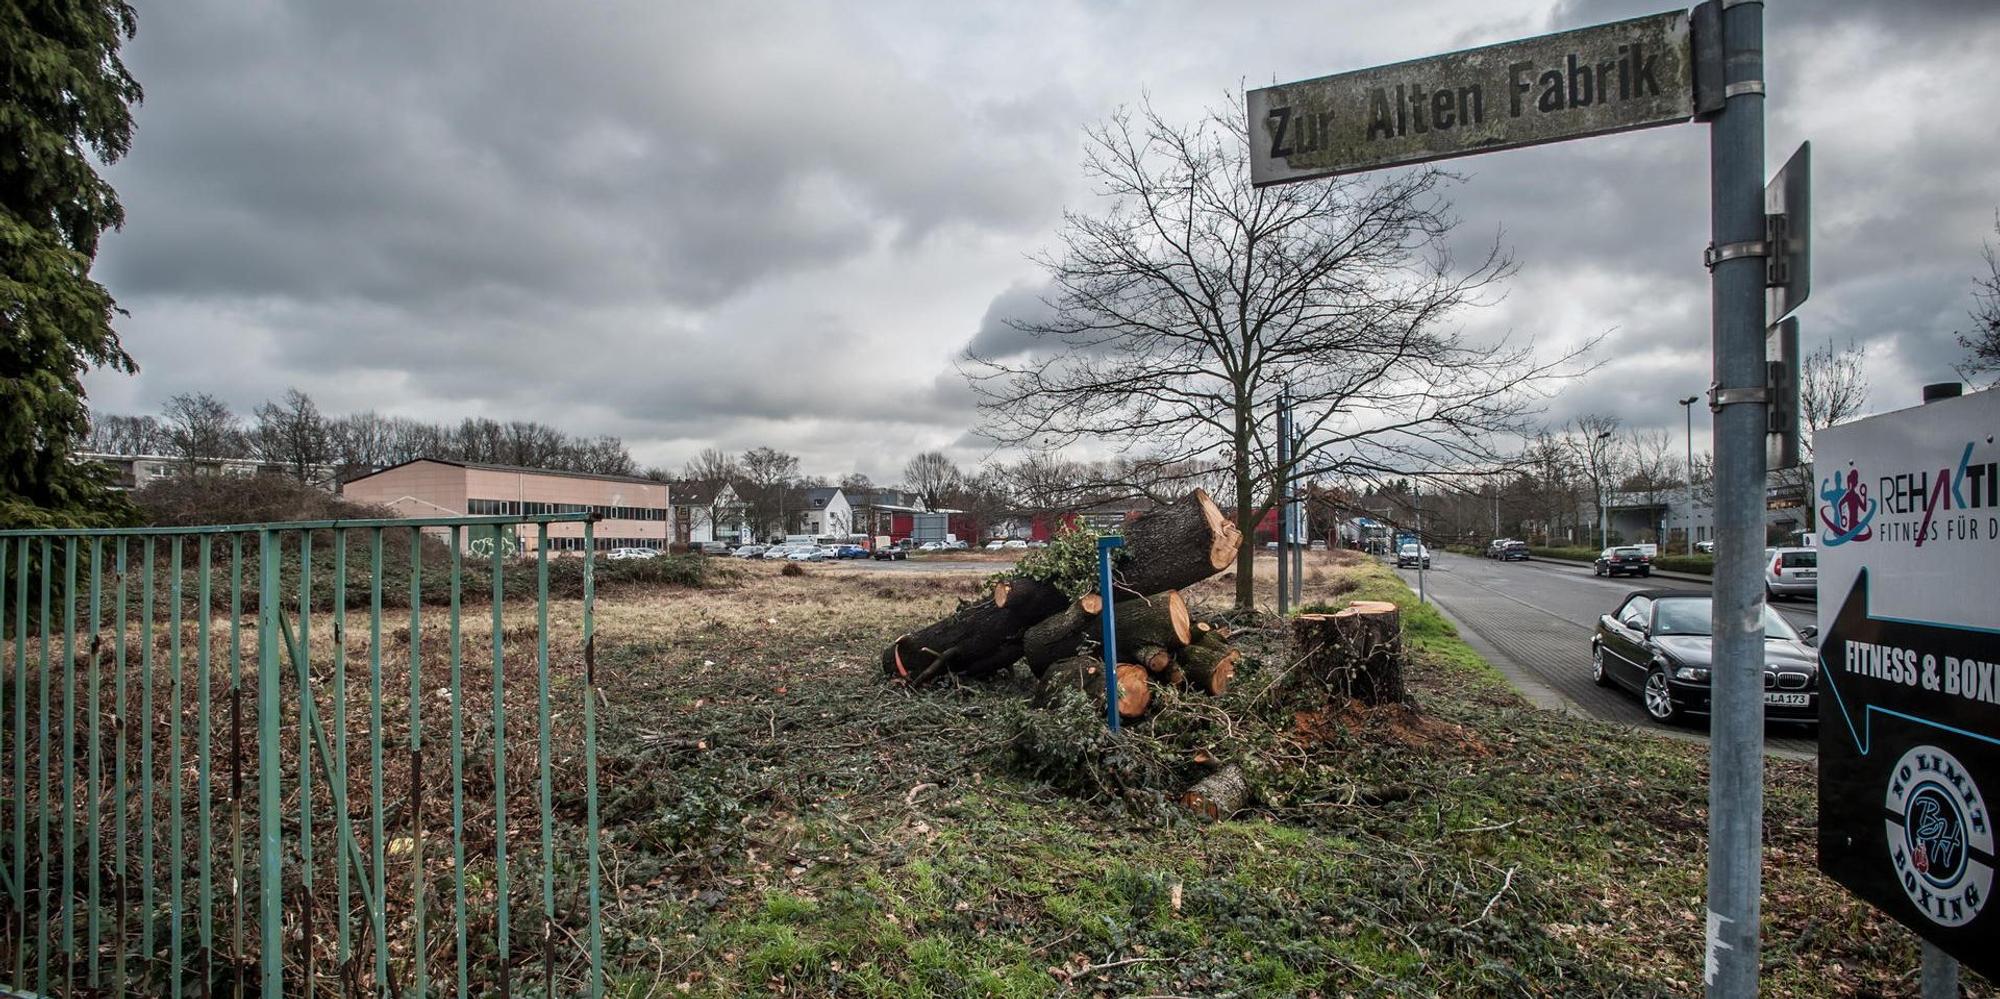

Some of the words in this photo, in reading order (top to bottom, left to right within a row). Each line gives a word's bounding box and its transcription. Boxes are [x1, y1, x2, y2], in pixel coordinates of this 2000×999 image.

[1268, 106, 1335, 159] Zur
[1366, 83, 1483, 142] Alten
[1508, 44, 1661, 117] Fabrik
[1880, 520, 1938, 542] FITNESS
[1948, 516, 1978, 540] FÜR
[1845, 639, 1918, 687] FITNESS
[1922, 654, 1941, 692] &
[1892, 764, 1912, 800] NO
[1916, 753, 1986, 836] LIMIT
[1894, 844, 1981, 921] BOXING
